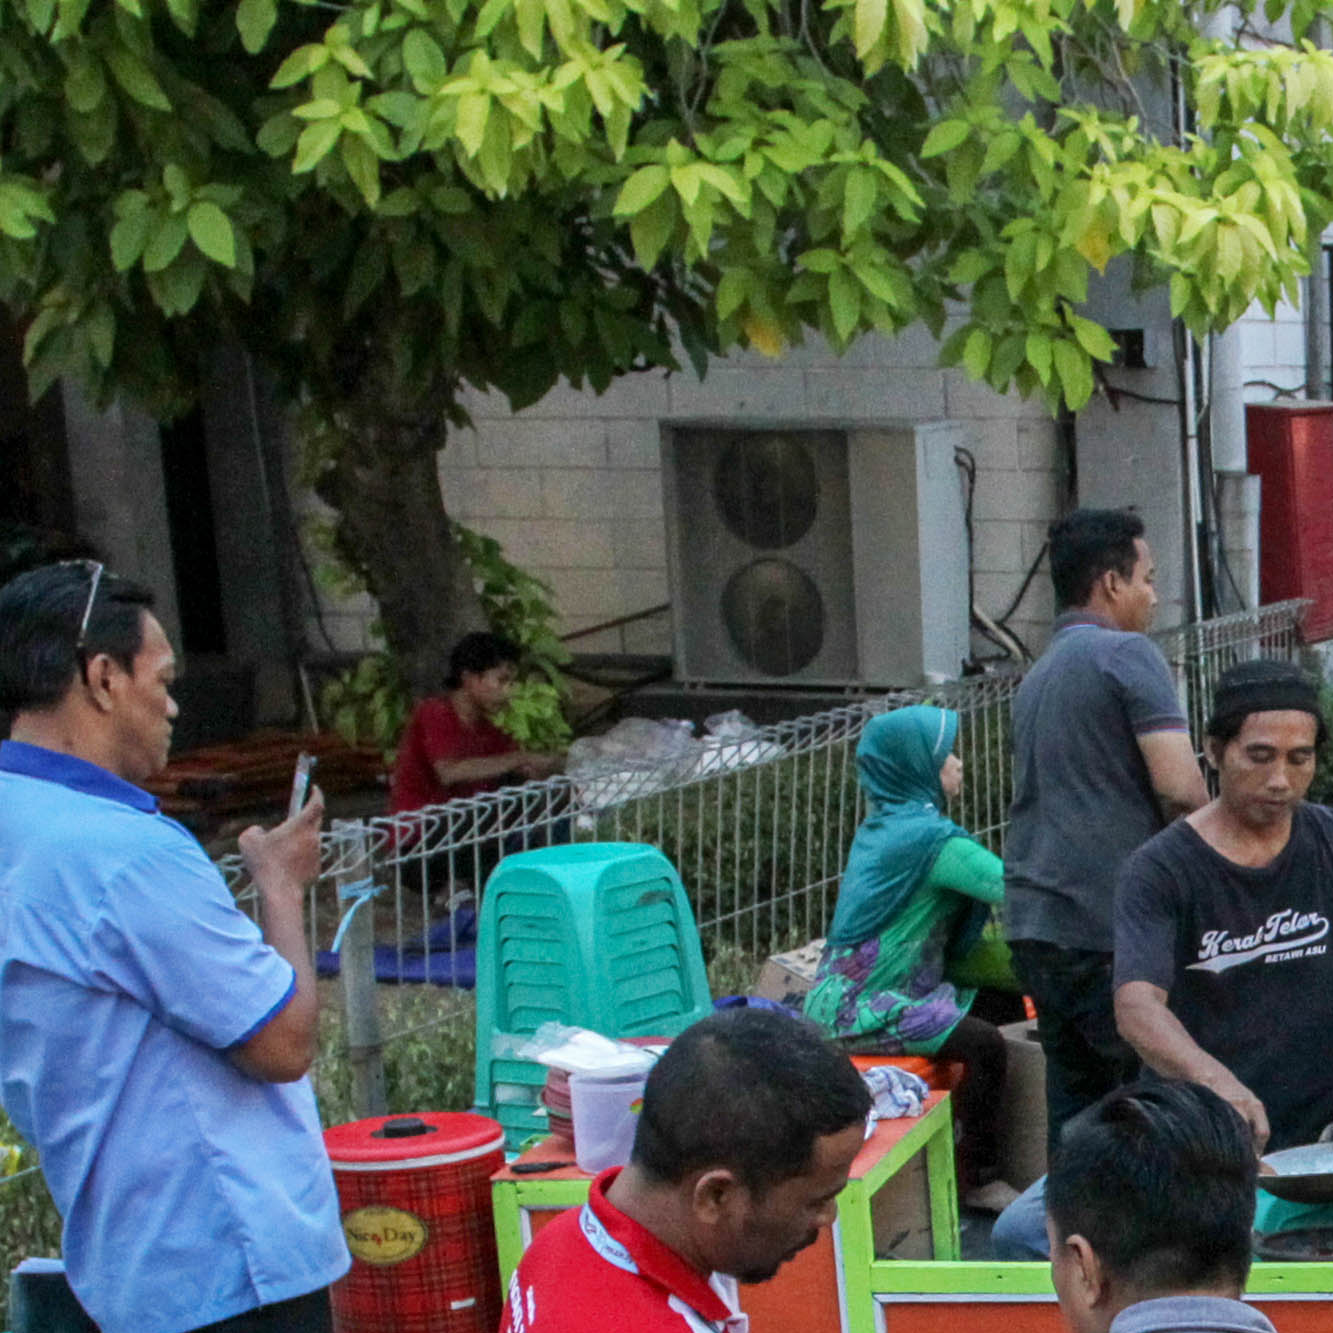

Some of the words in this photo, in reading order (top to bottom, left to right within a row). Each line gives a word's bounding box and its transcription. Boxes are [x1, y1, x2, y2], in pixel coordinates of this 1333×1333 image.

[1264, 949, 1304, 964] BETAWI
[1305, 945, 1328, 957] ASLI
[383, 1228, 417, 1245] Day
